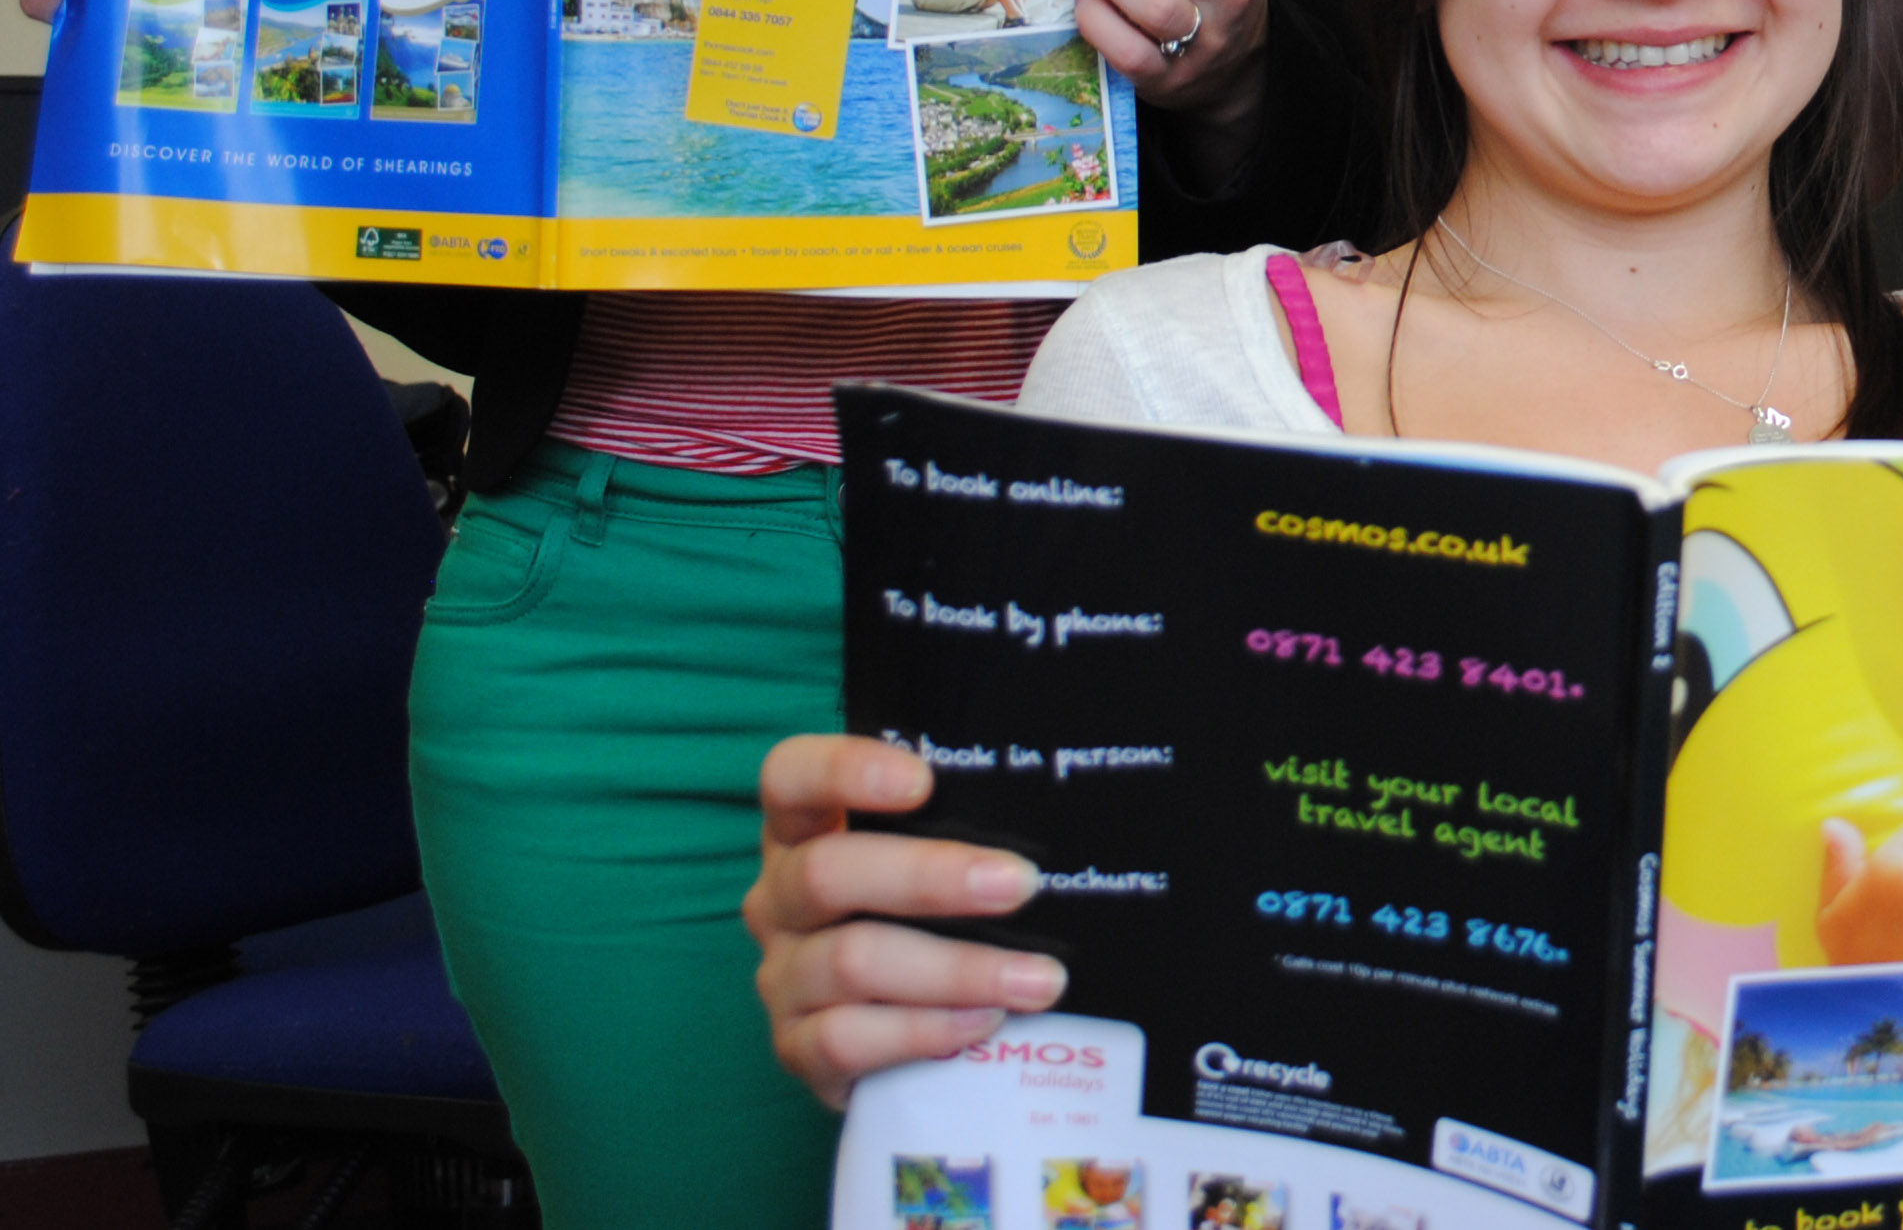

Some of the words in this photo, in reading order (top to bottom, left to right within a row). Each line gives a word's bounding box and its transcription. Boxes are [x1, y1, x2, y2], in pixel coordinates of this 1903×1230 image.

[708, 6, 736, 19] 0844
[764, 13, 792, 27] 7057
[109, 142, 212, 163] DISCOVER
[223, 151, 255, 166] THE
[267, 154, 332, 170] WORLD
[342, 157, 365, 171] OF
[375, 159, 473, 177] SHEARINGS
[442, 236, 472, 249] ABTA
[884, 458, 919, 487] To
[926, 460, 998, 498] book
[1008, 476, 1125, 506] online:
[1255, 509, 1531, 566] cosmos.co.uk
[884, 589, 917, 618] To
[923, 591, 998, 628] book
[1006, 600, 1044, 646] by
[1055, 606, 1164, 646] phone:
[1246, 628, 1343, 665] 0871
[1362, 645, 1442, 680] 423
[920, 733, 997, 766] book
[1008, 743, 1043, 766] in
[1055, 746, 1174, 778] person:
[1264, 756, 1349, 790] visit
[1368, 774, 1461, 811] your
[1479, 781, 1580, 827] local
[1299, 792, 1416, 837] travel
[1434, 822, 1544, 860] agent
[1037, 866, 1169, 890] rochure:
[1635, 852, 1661, 936] Cosmos
[1255, 890, 1352, 924] 0871
[1371, 903, 1448, 939] 423
[936, 1040, 1105, 1068] SMOS
[1243, 1059, 1331, 1090] recycle
[1470, 1141, 1525, 1174] ABTA
